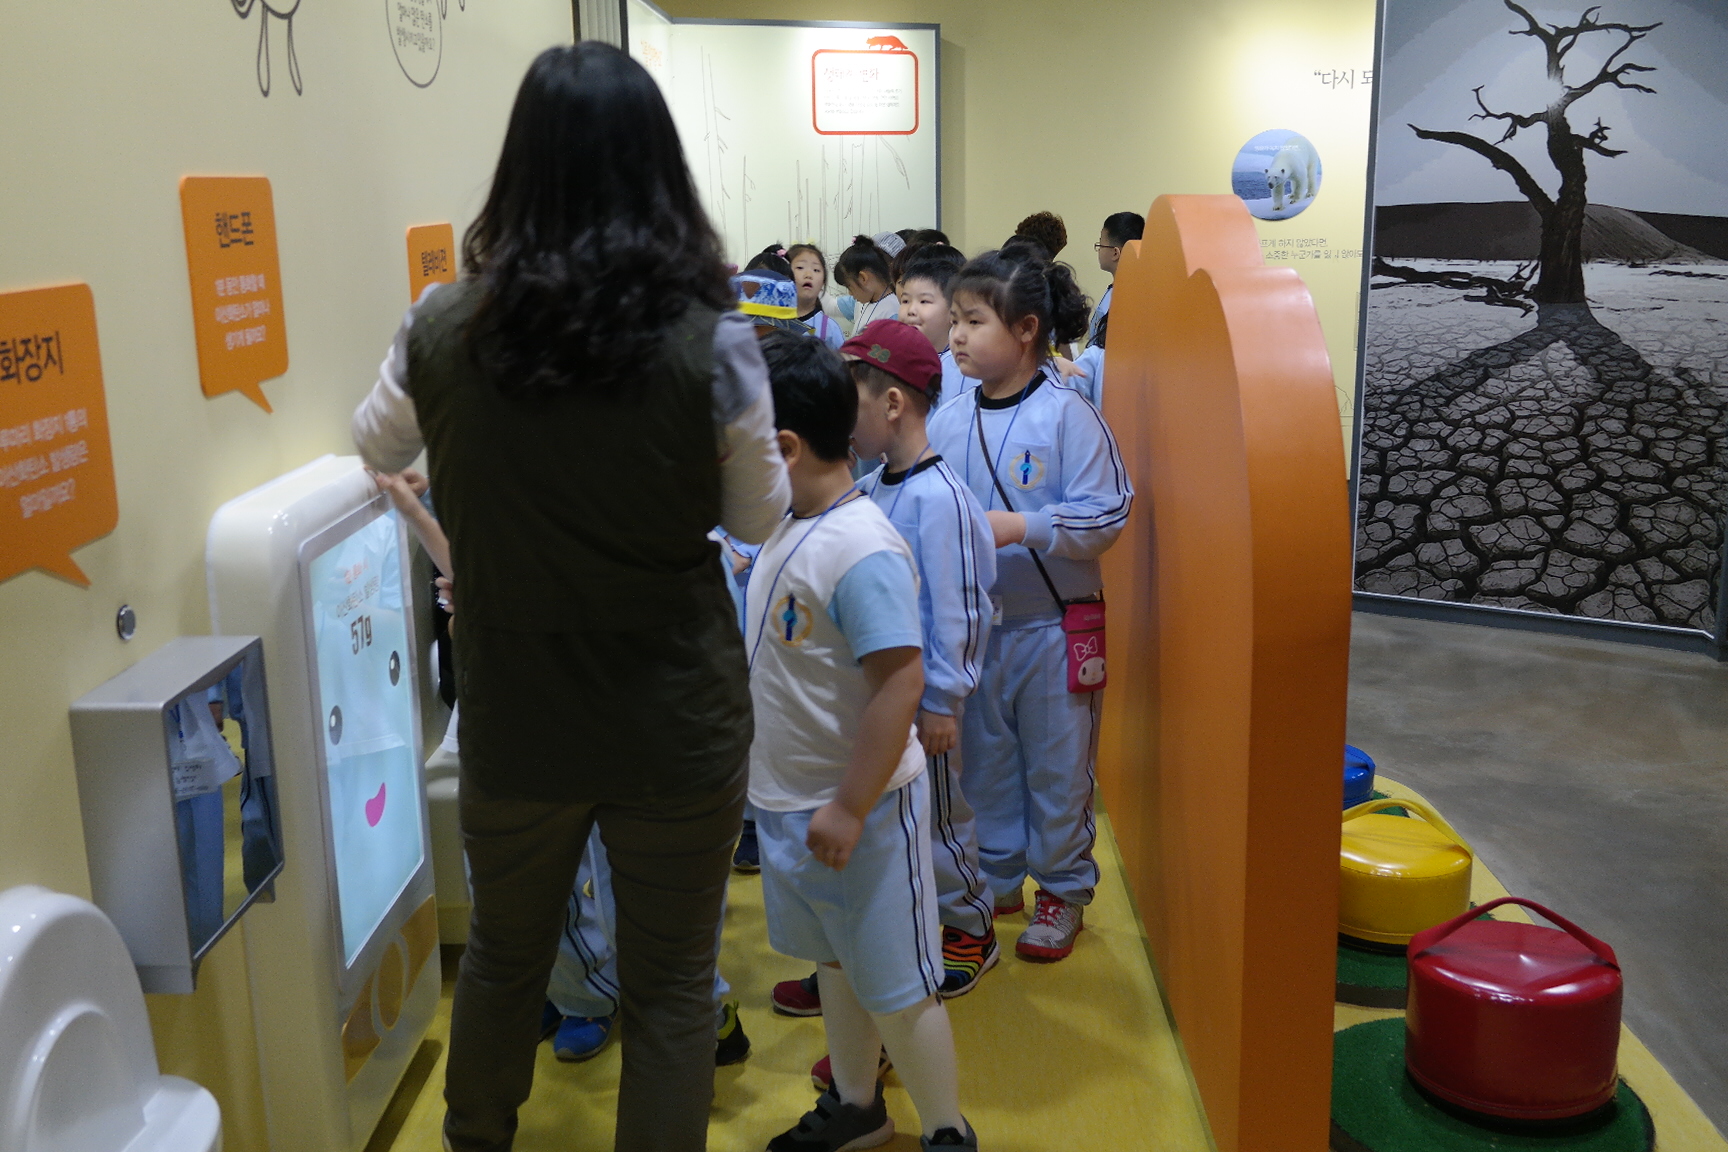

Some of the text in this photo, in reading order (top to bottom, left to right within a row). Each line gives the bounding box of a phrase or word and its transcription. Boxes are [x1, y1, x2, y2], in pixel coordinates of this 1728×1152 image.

[215, 211, 254, 249] 핸드폰
[1260, 238, 1276, 248] 프게
[1278, 238, 1294, 248] 하지
[1265, 250, 1289, 260] 소중한
[1291, 250, 1321, 260] 누군가를
[0, 331, 64, 385] 화장지
[351, 615, 372, 655] 57g
